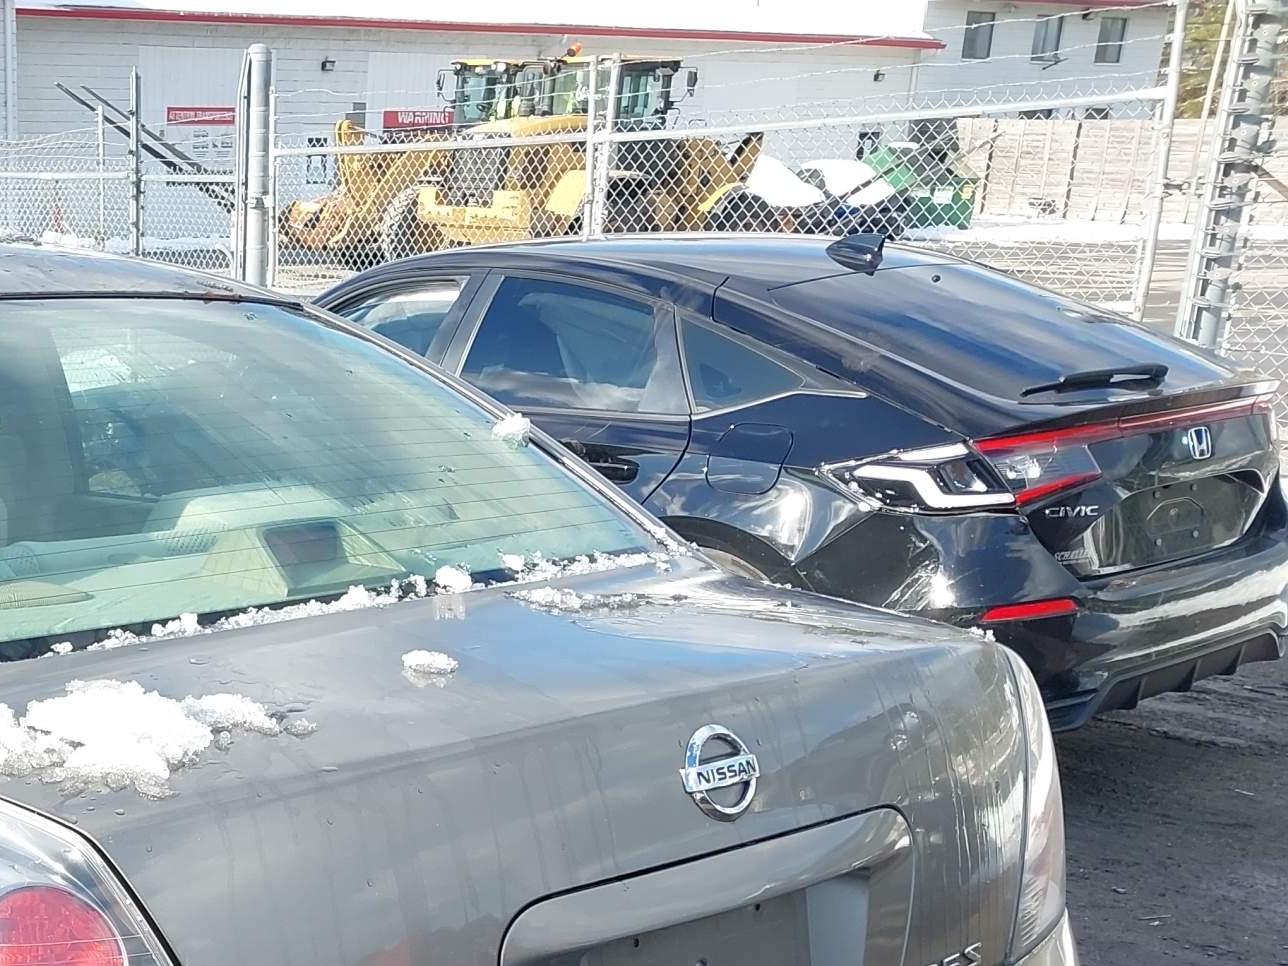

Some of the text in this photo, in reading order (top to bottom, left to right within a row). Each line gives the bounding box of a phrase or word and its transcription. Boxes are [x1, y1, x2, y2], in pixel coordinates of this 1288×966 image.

[397, 111, 449, 124] WARNING
[1044, 505, 1099, 518] CIVIC
[697, 759, 757, 785] NISSAN
